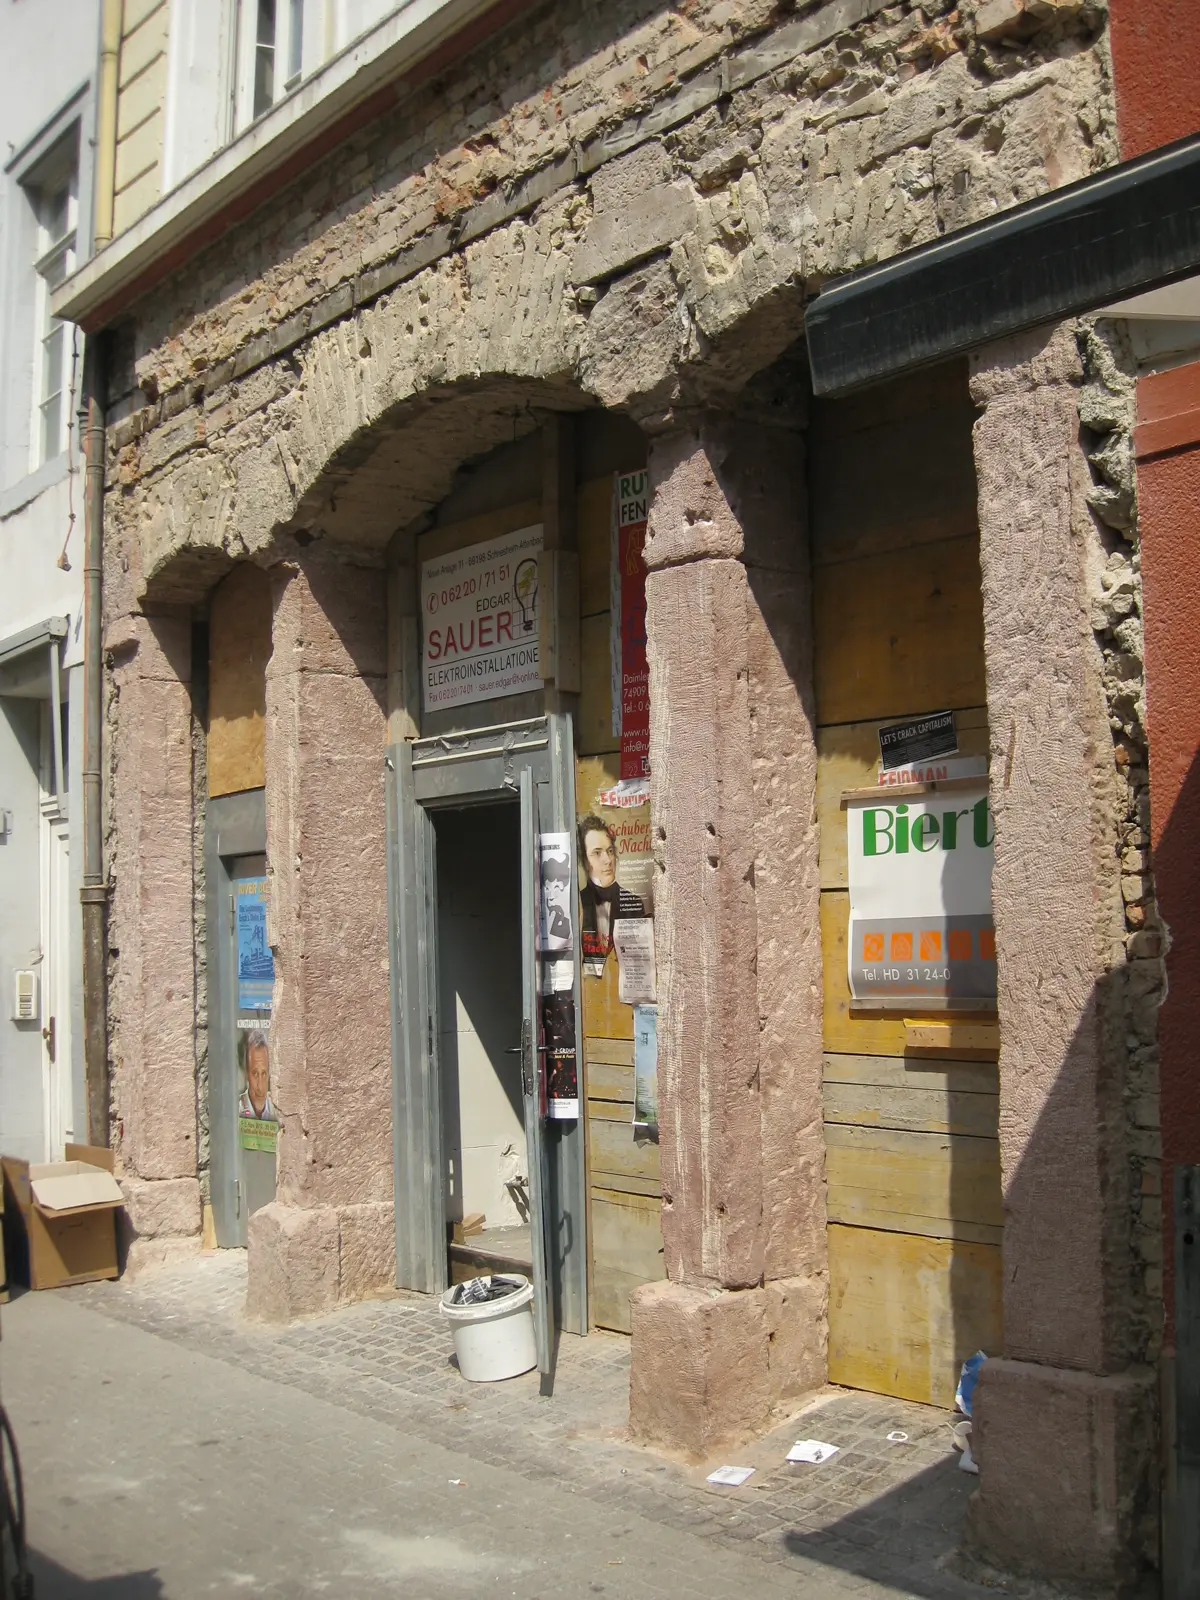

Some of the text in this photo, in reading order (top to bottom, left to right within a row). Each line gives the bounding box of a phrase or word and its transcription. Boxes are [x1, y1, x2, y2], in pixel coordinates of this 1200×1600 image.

[622, 499, 646, 523] FEN
[476, 592, 511, 612] EDGAR
[428, 610, 514, 660] SAUER
[428, 647, 540, 687] ELEKTROINSTALLATIONE
[623, 686, 646, 699] 74909
[881, 716, 952, 745] LET'S CRACK CAPITALISM
[862, 968, 951, 981] Tel. HD 31 24-0
